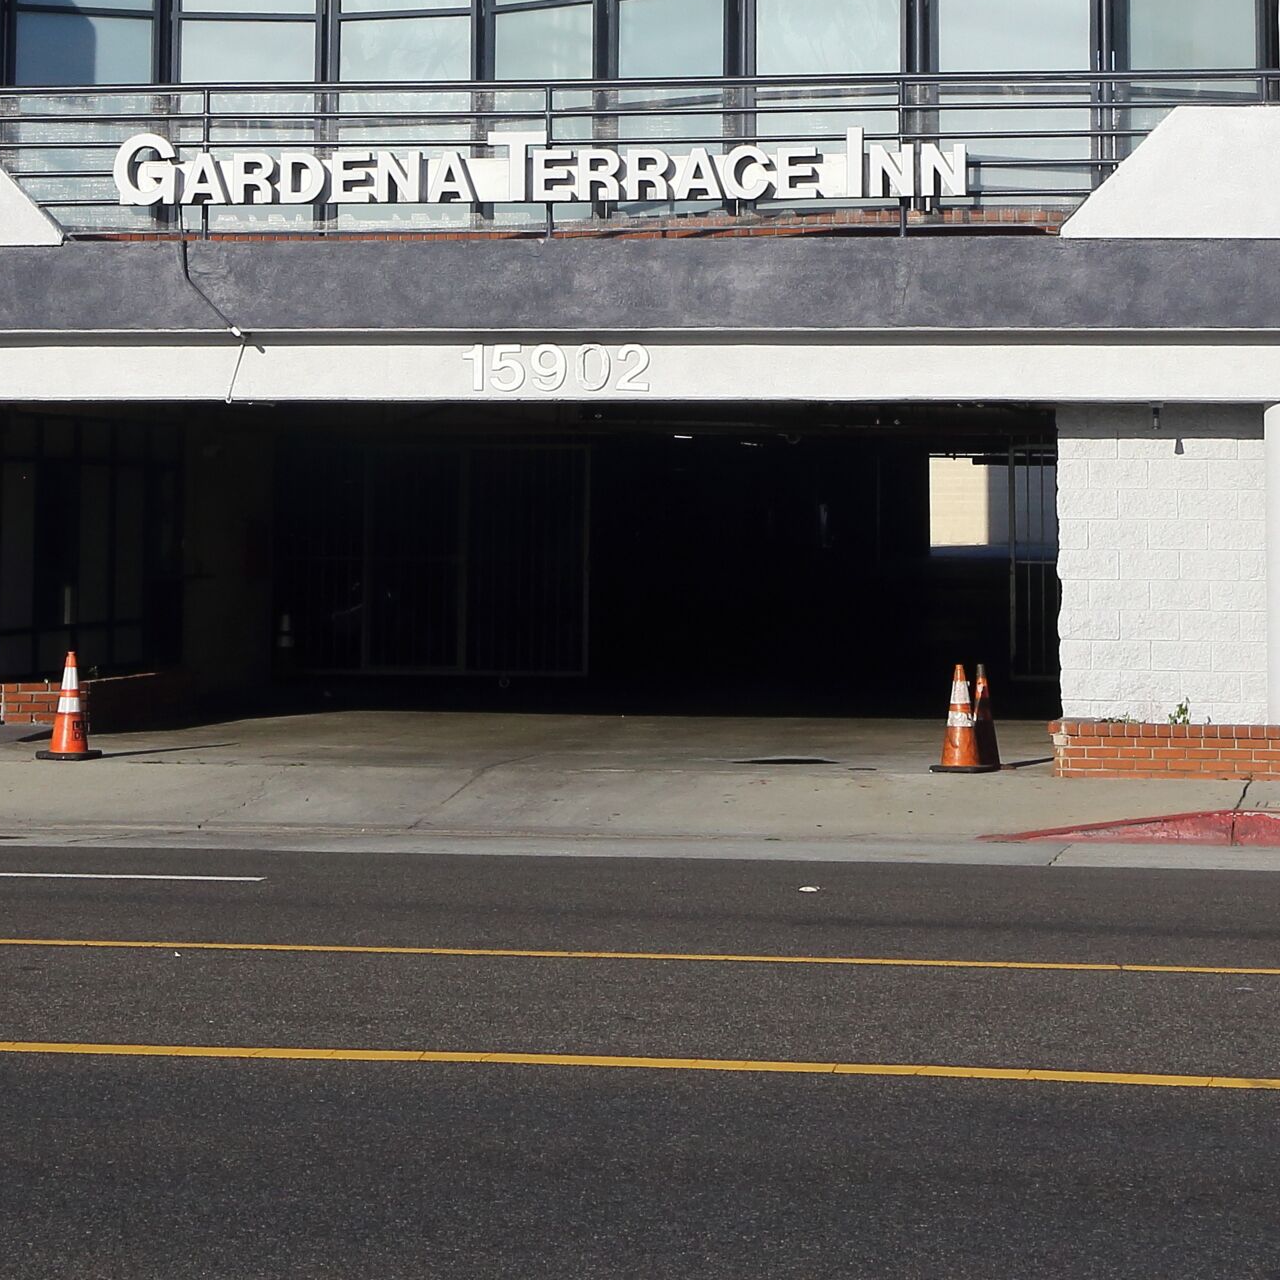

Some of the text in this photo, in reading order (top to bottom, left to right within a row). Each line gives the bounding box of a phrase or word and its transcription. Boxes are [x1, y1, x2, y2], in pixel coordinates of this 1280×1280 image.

[113, 127, 968, 205] GARDENA TERRACE INN
[462, 343, 651, 392] 15902
